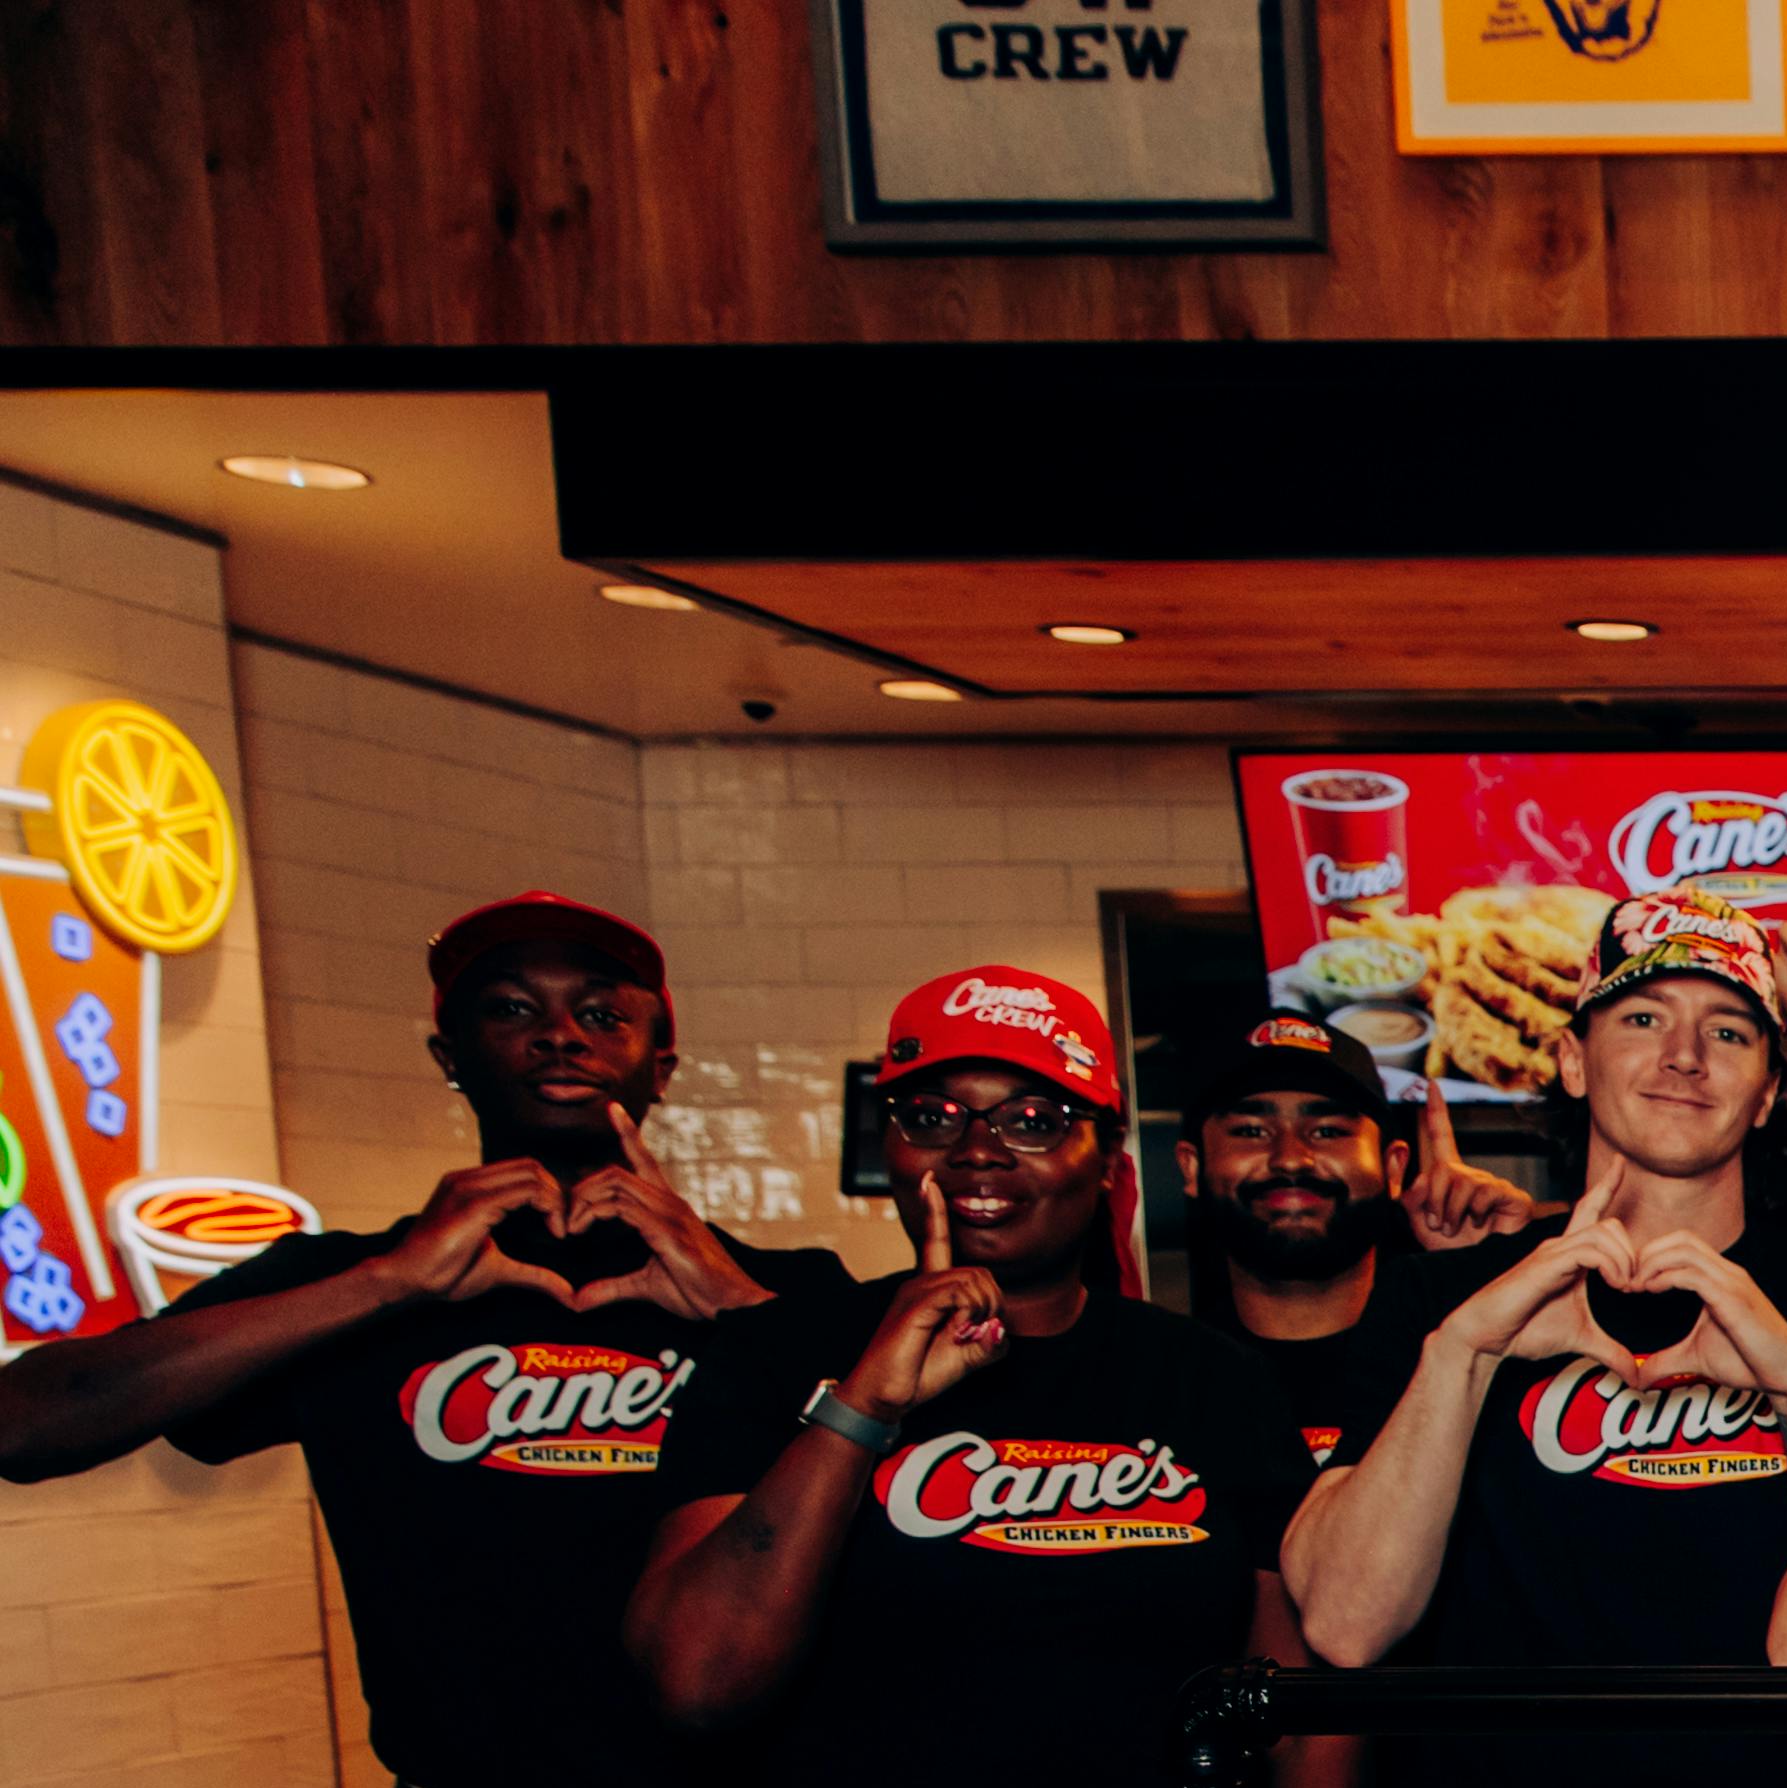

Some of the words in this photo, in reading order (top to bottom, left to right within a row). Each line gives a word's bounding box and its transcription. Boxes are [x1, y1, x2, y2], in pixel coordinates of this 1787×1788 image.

[936, 21, 1188, 82] CREW
[1306, 852, 1403, 905] Cane's
[1642, 904, 1744, 943] Cane's
[975, 1005, 1063, 1037] CREW
[523, 1347, 628, 1374] Raising
[517, 1446, 603, 1462] CHICKEN
[1003, 1443, 1108, 1464] Raising
[1628, 1459, 1701, 1476] CHICKEN
[1708, 1458, 1781, 1475] FINGERS
[886, 1431, 1199, 1538] Cane's
[1004, 1526, 1096, 1542] CHICKEN
[1105, 1525, 1190, 1541] FINGERS
